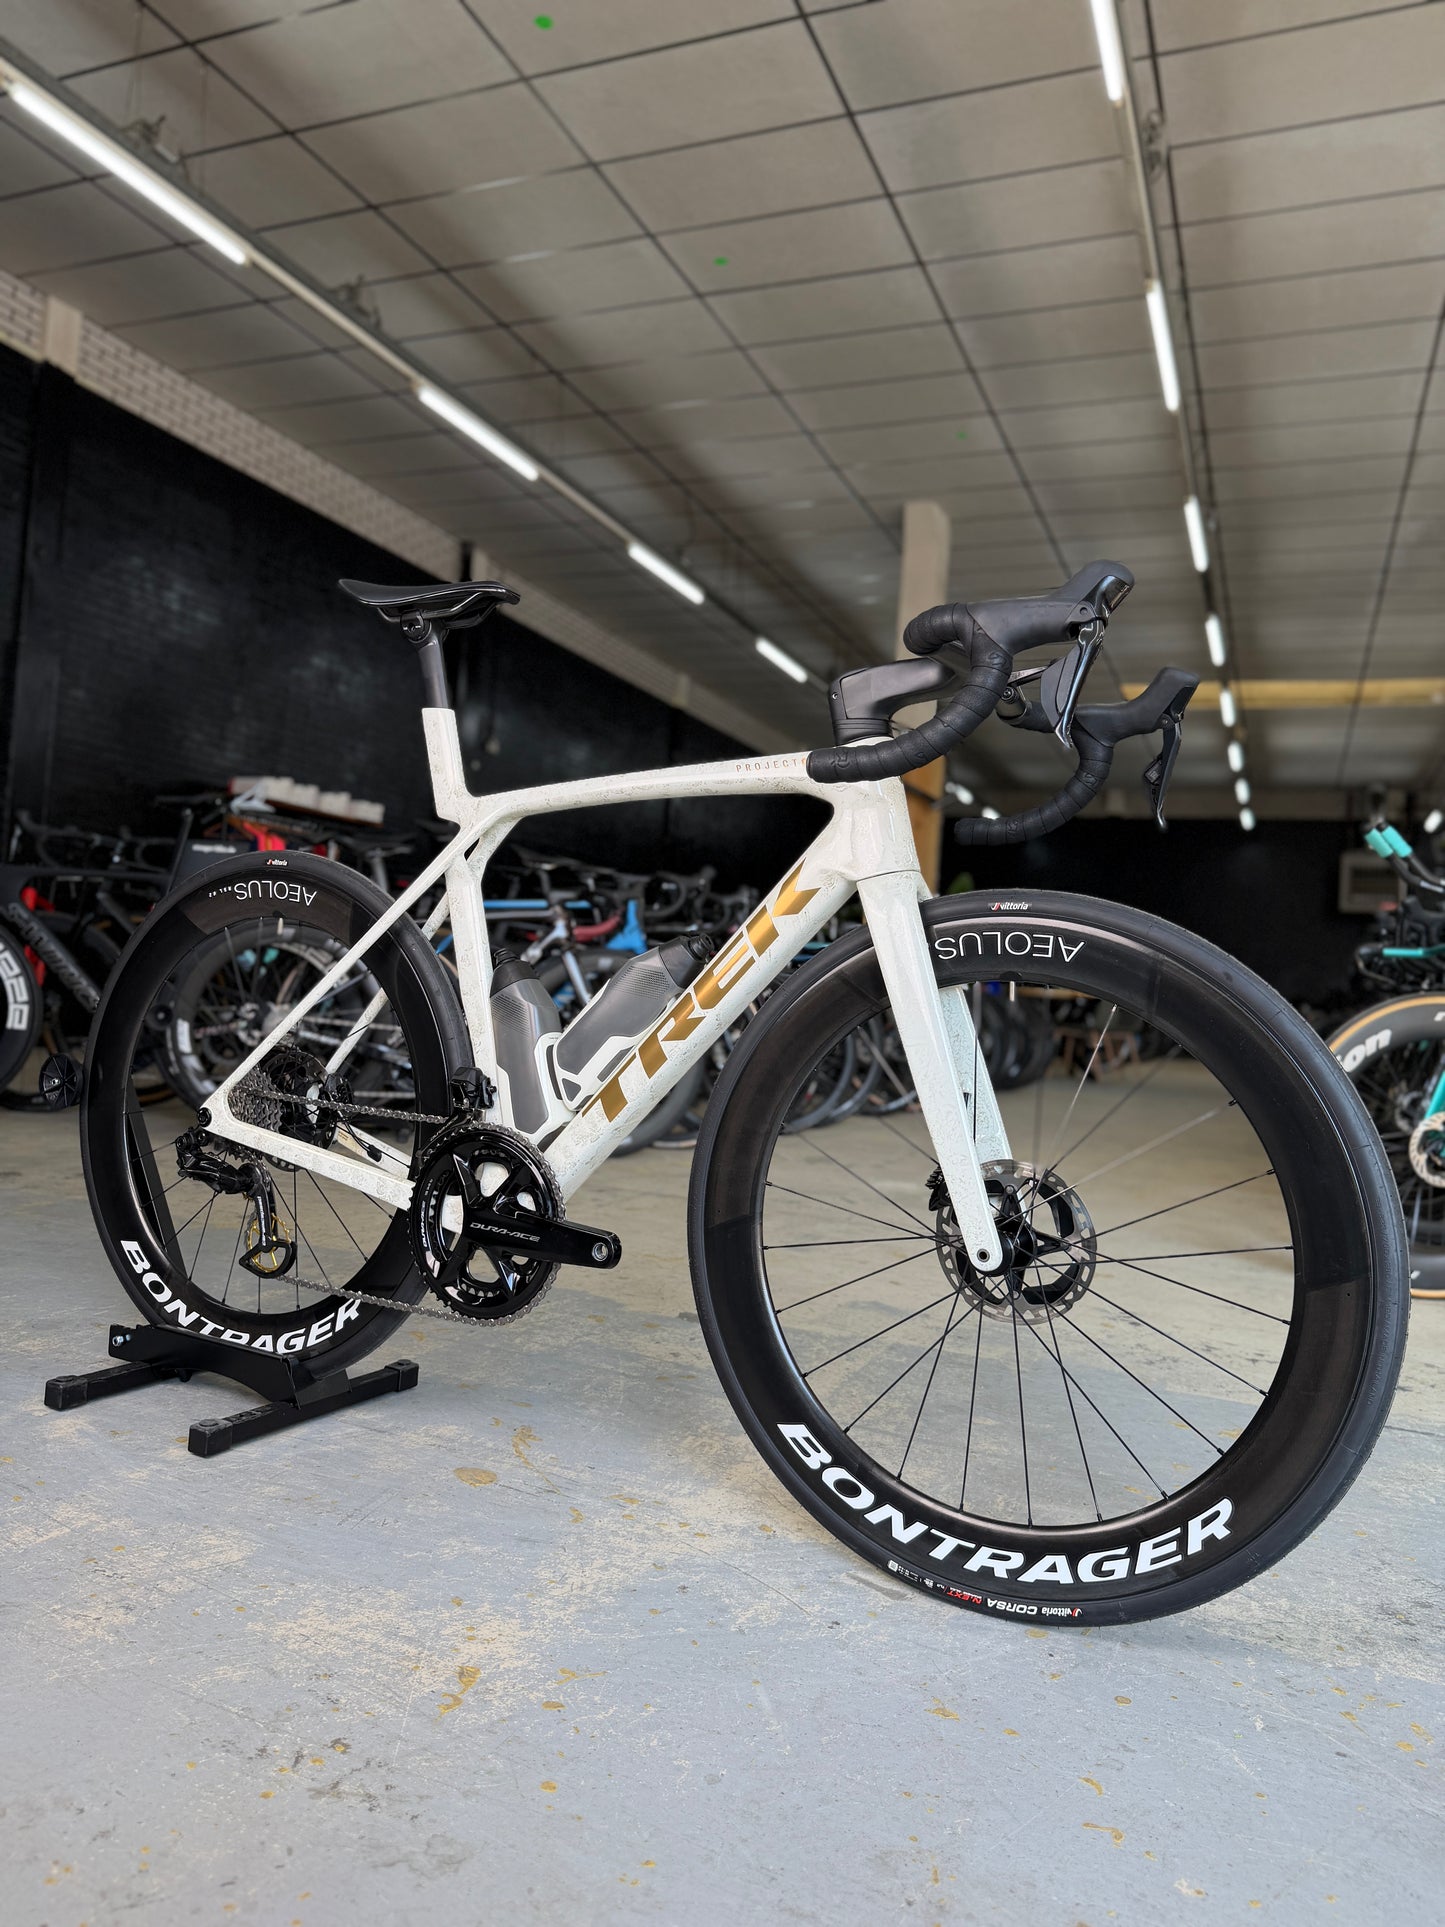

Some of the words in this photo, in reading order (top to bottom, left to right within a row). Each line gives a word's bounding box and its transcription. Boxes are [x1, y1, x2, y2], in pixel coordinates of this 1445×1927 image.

[736, 759, 797, 772] PROJECT
[234, 880, 317, 906] AEOLUS
[999, 902, 1029, 911] vittoria
[934, 931, 1085, 963] AEOLUS
[581, 856, 822, 1123] TREK
[469, 1222, 541, 1242] DURA-ACE
[776, 1422, 1234, 1584] BONTRAGER
[986, 1598, 1038, 1615] CORSA
[1041, 1607, 1073, 1617] vittoria
